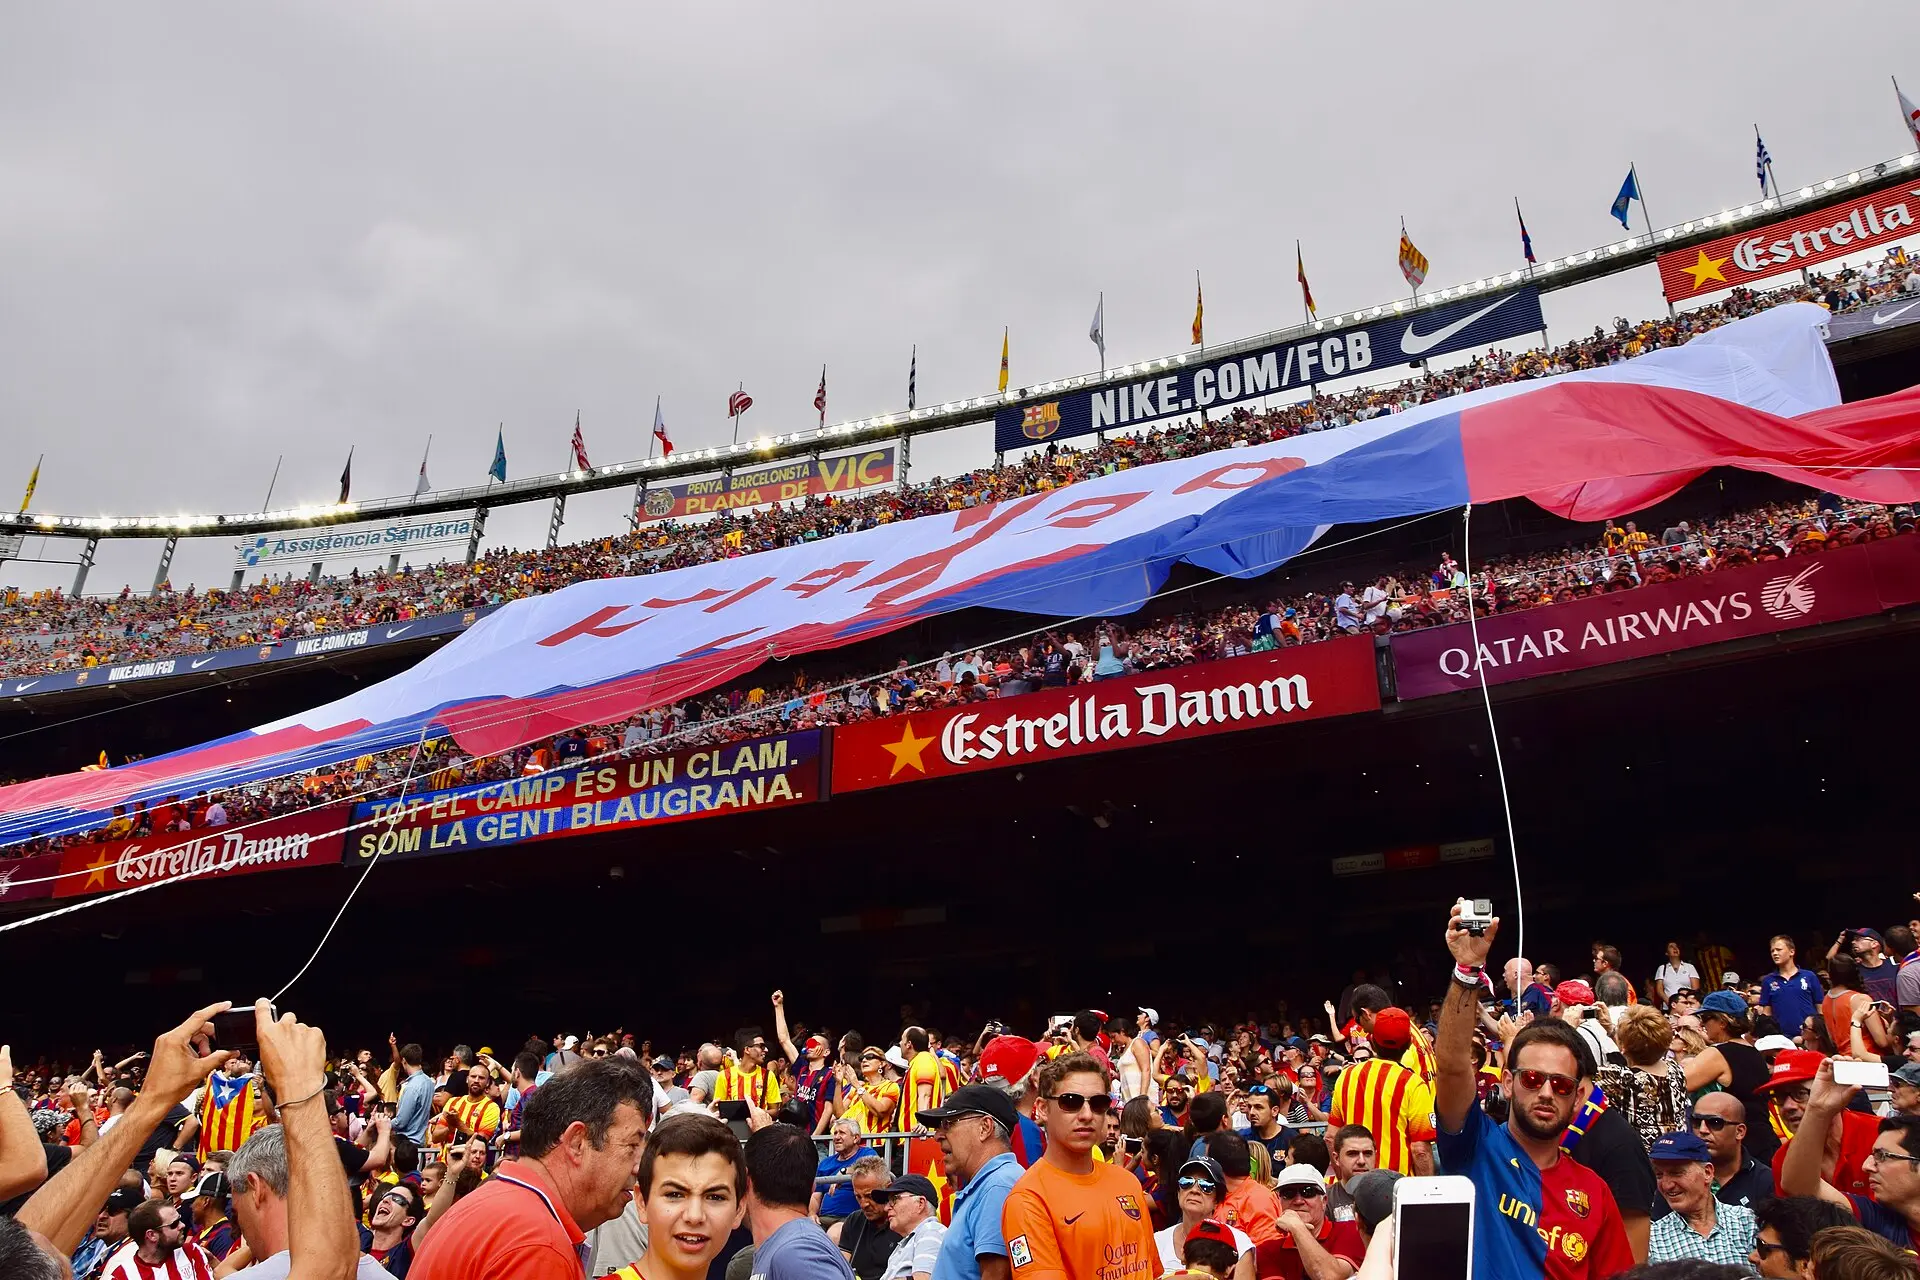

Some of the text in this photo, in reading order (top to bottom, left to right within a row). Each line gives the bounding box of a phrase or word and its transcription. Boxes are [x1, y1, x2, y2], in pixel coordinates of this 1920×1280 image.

[1733, 203, 1915, 271] Estrella
[1091, 330, 1372, 429] NIKE.COM/FCB
[685, 451, 885, 514] PLANA DE VIC
[687, 463, 810, 495] PENYA BARCELONISTA
[294, 630, 369, 655] NIKE.COM/FCB
[1439, 592, 1752, 679] QATAR AIRWAYS
[108, 660, 175, 681] NIKE.COM/FCB
[940, 673, 1313, 764] Estrella Damm
[359, 773, 803, 858] SOM LA GENT BLAUGRANA.
[370, 740, 798, 828] TOT EL CAMP ÉS UN CLAM.
[115, 833, 310, 883] Estrella Damm
[1104, 1241, 1137, 1265] Qatar
[1498, 1193, 1562, 1251] unief
